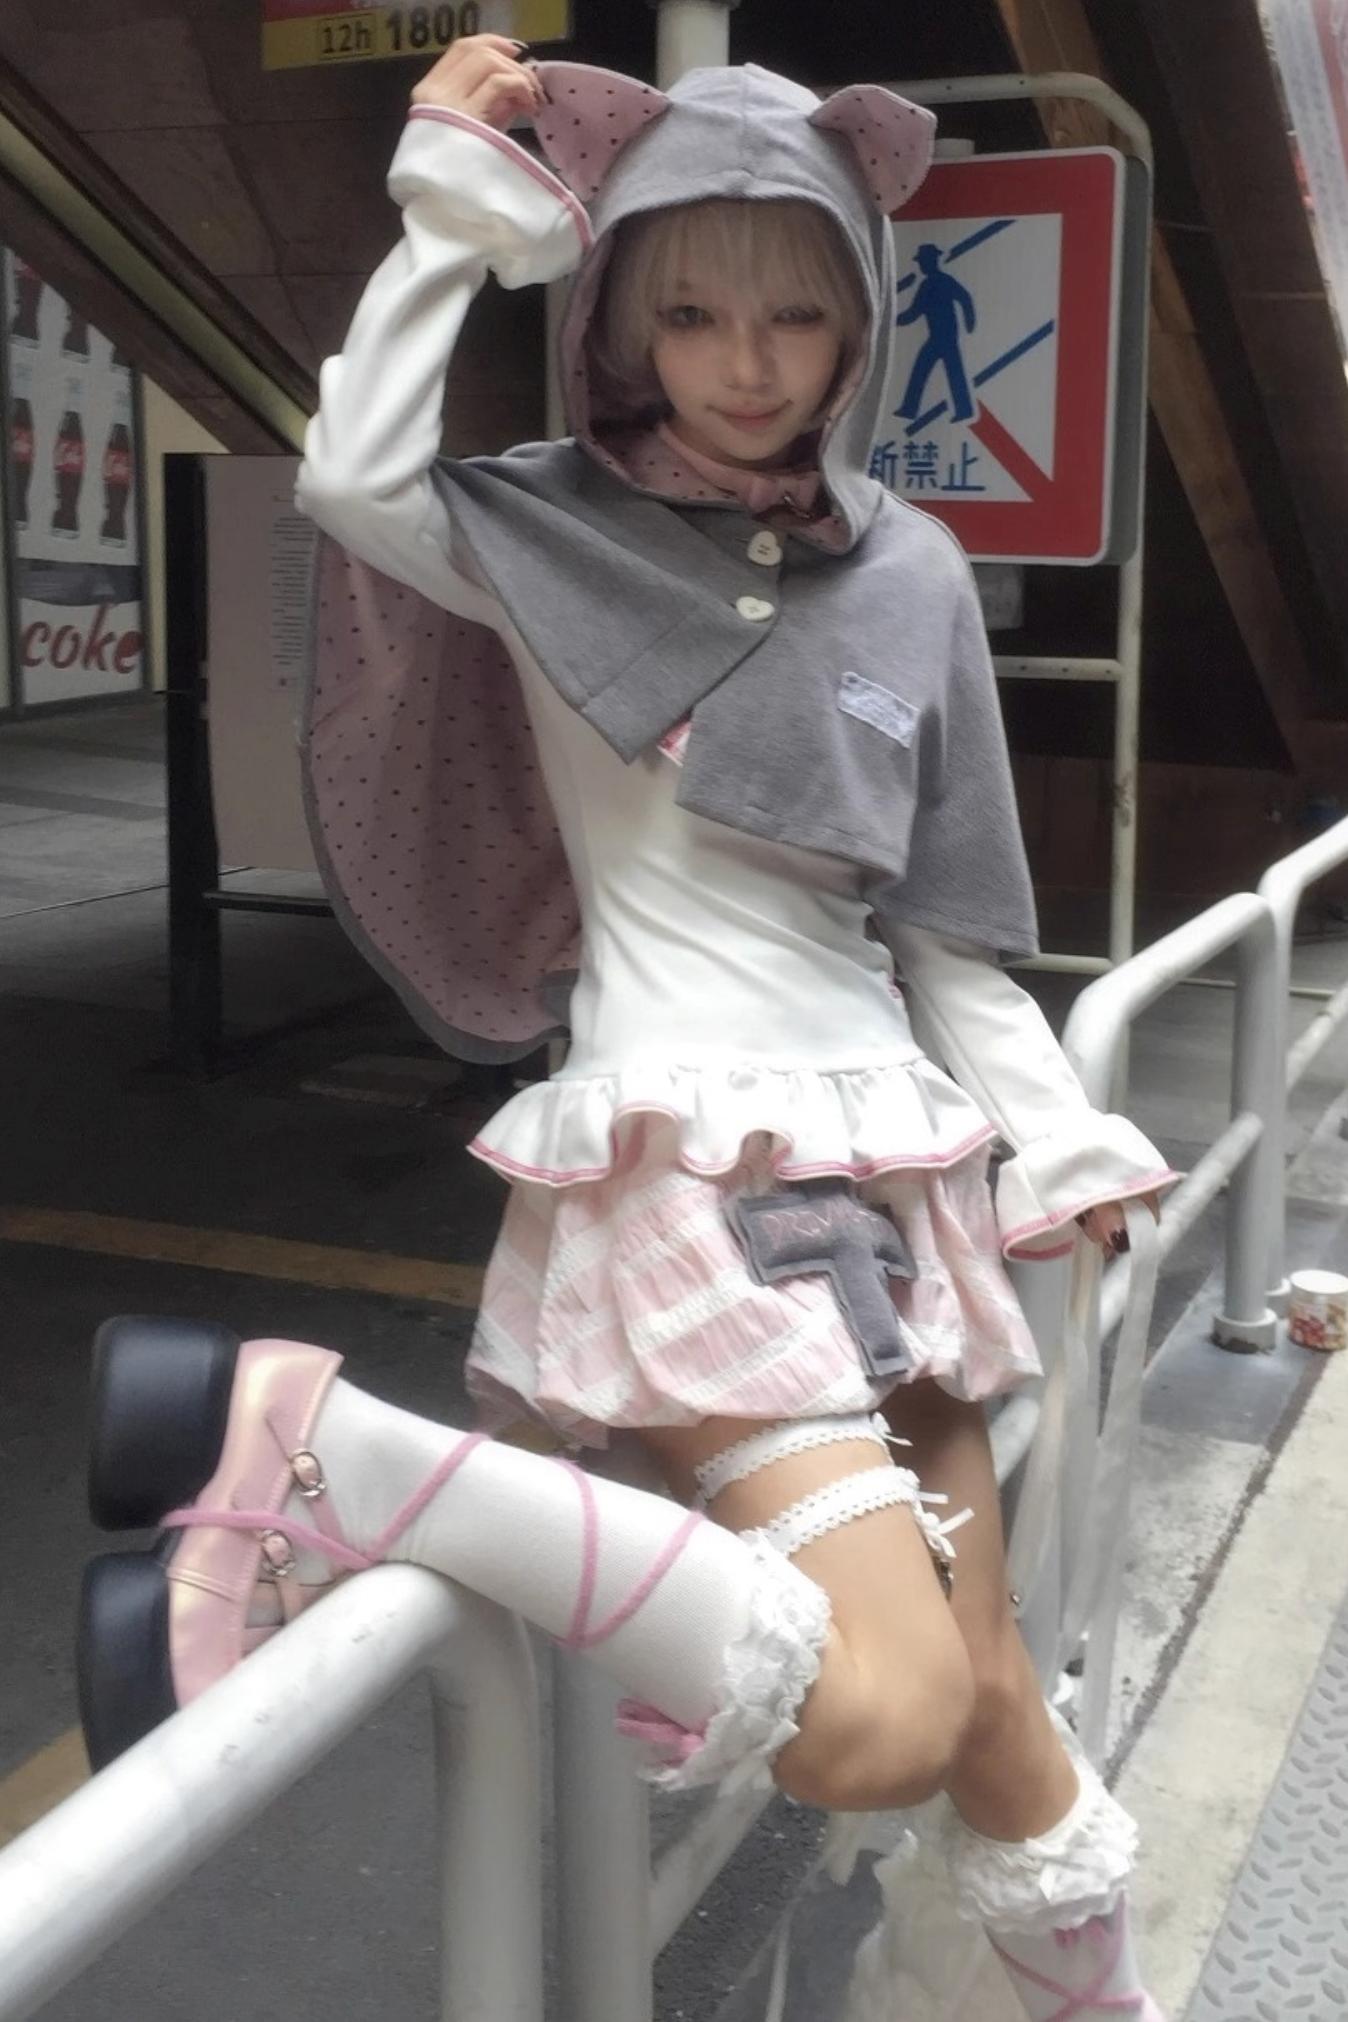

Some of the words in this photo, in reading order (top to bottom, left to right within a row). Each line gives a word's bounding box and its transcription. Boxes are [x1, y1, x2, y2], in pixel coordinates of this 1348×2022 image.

[322, 20, 371, 54] 12h
[386, 0, 480, 50] 1800
[20, 600, 145, 674] coke
